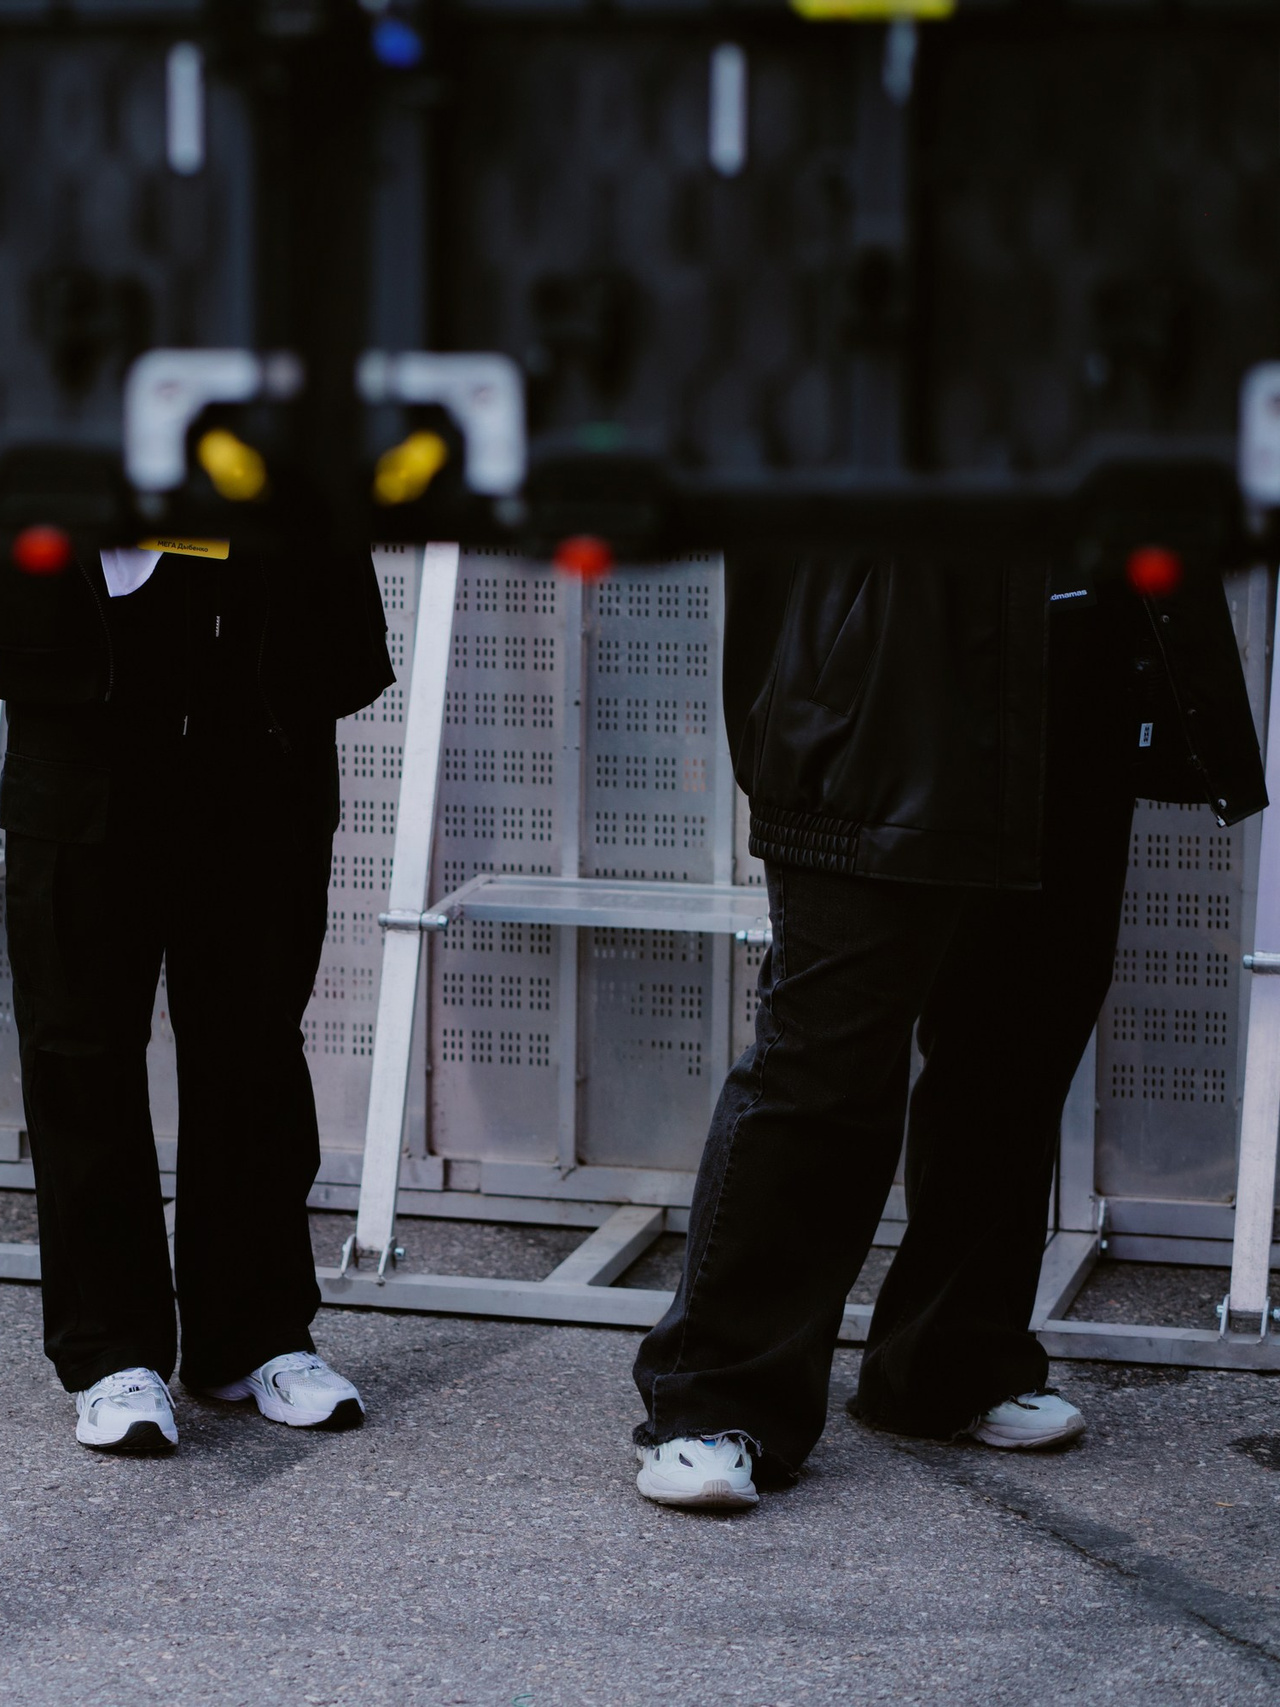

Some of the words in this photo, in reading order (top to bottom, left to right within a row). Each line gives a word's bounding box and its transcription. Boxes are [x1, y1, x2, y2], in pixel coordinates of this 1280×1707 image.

[157, 540, 177, 549] МЕГА
[177, 542, 209, 553] Дыбенко
[1050, 589, 1088, 601] dmamas
